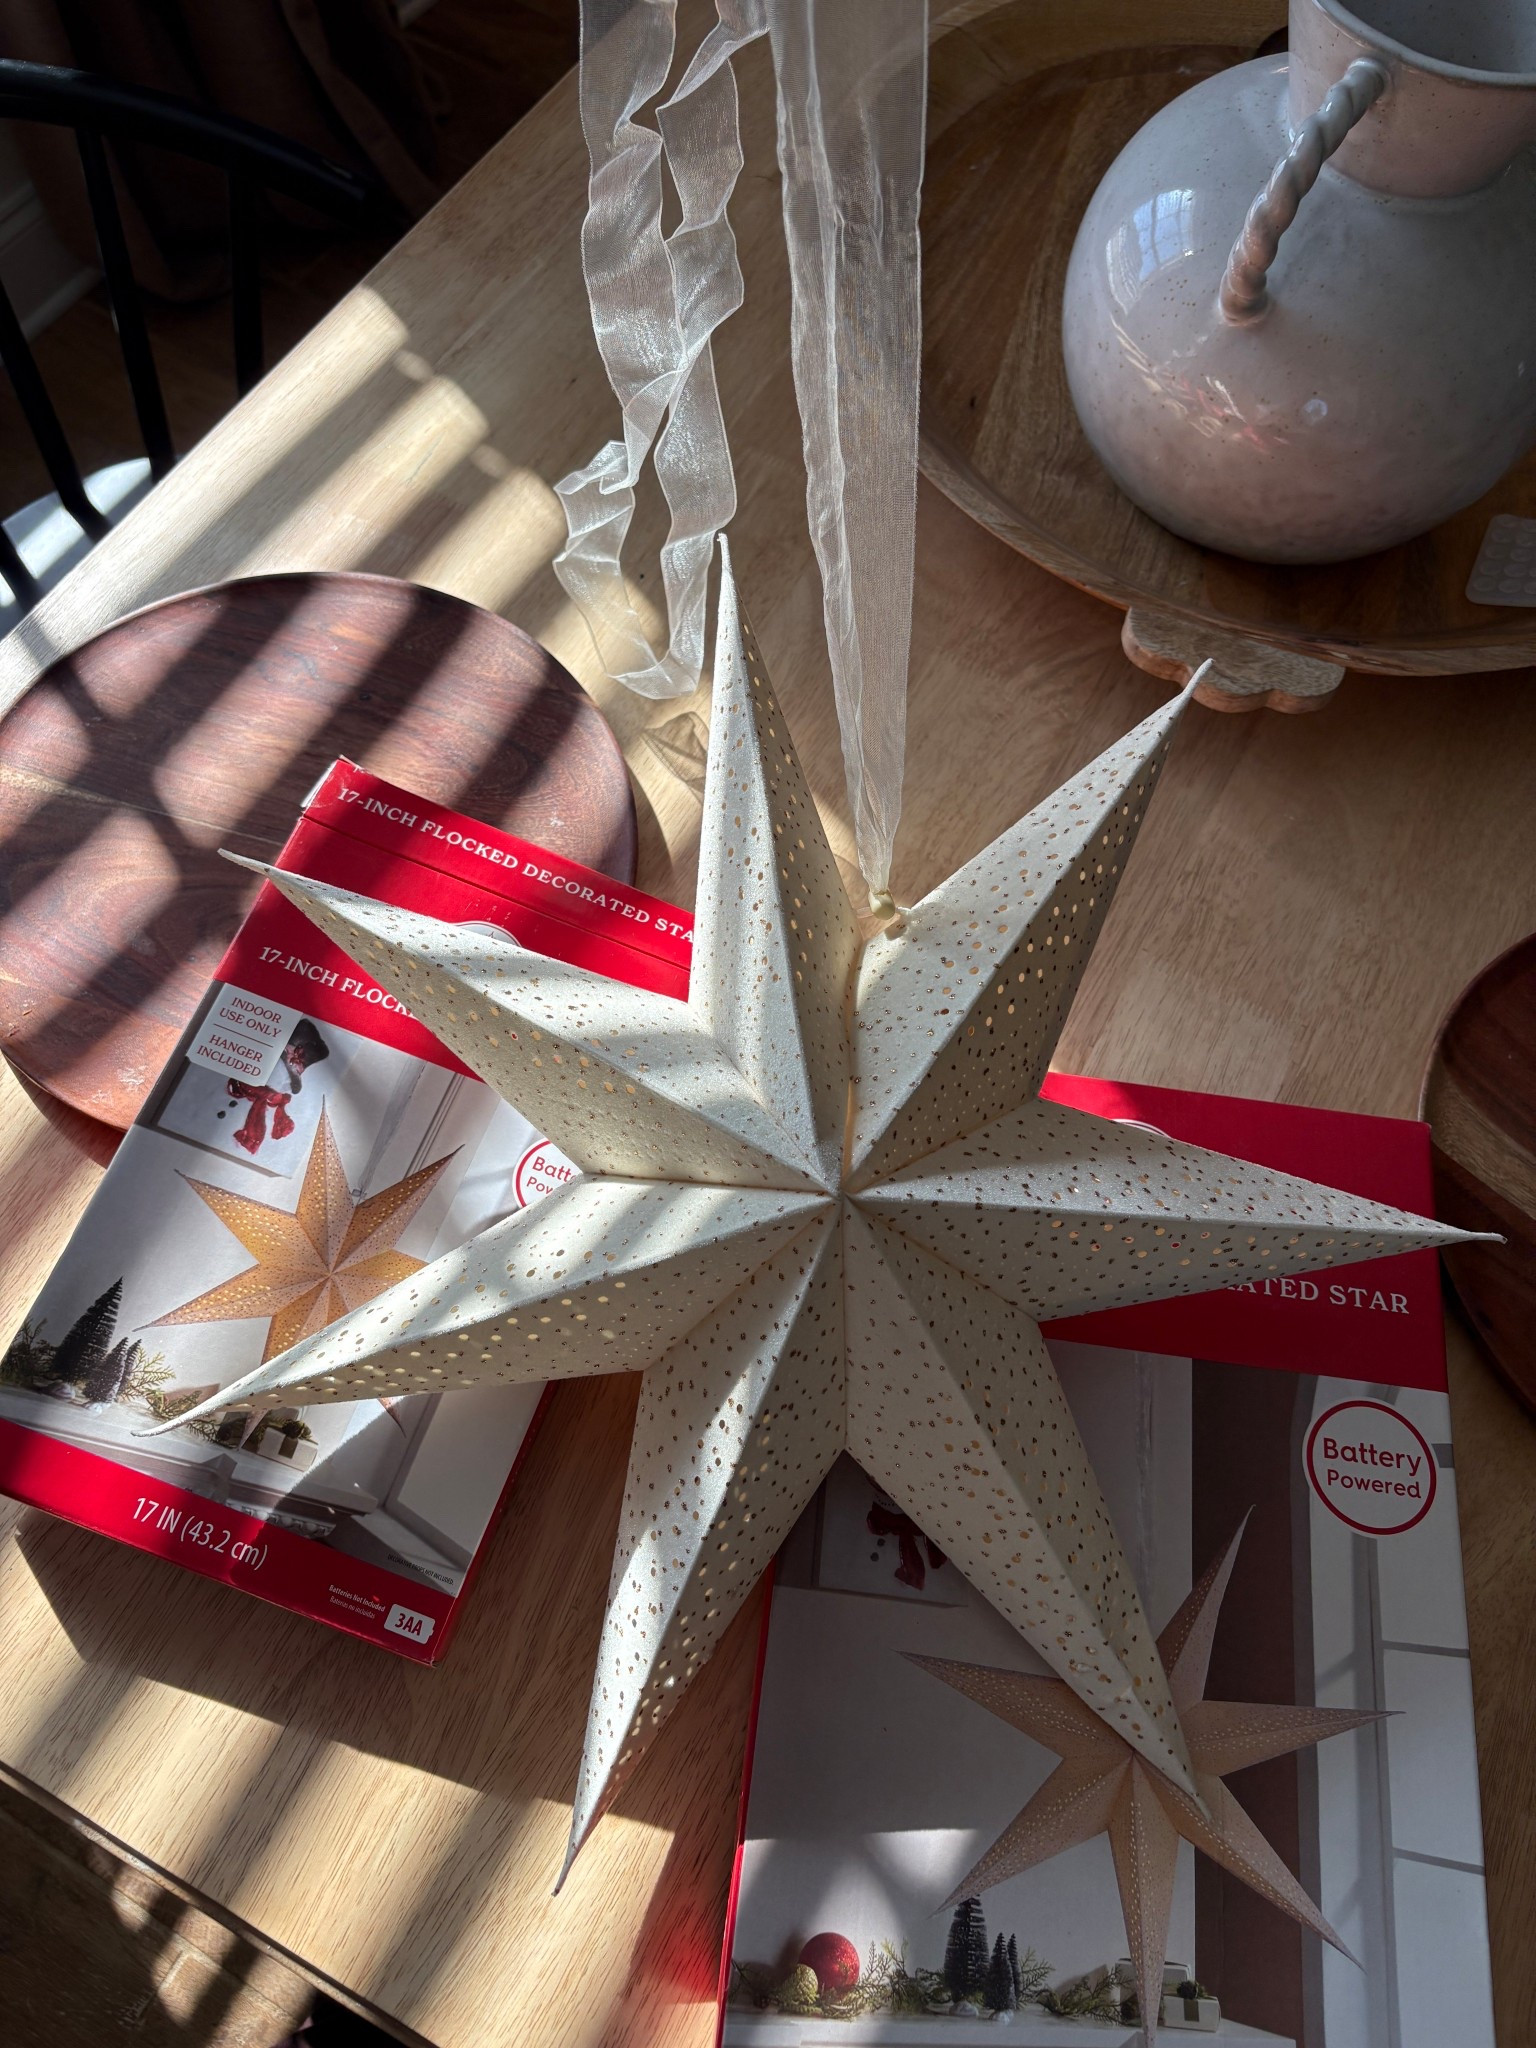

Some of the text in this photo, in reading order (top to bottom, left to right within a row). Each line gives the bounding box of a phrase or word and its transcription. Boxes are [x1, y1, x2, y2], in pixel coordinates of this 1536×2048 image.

[338, 788, 418, 827] 17-INCH
[421, 820, 518, 869] FLOCKED
[522, 863, 650, 923] DECORATED
[259, 946, 340, 987] 17-INCH
[220, 1007, 282, 1038] USE ONLY
[232, 997, 282, 1024] INDOOR
[197, 1045, 262, 1077] INCLUDED
[208, 1034, 263, 1062] HANGER
[1330, 1284, 1410, 1314] STAR
[1323, 1437, 1421, 1476] Battery
[1327, 1468, 1421, 1498] Powered
[133, 1498, 268, 1571] 17 IN (43.2 cm)
[329, 1584, 386, 1612] Batteries Not Included
[394, 1613, 424, 1636] 3AA
